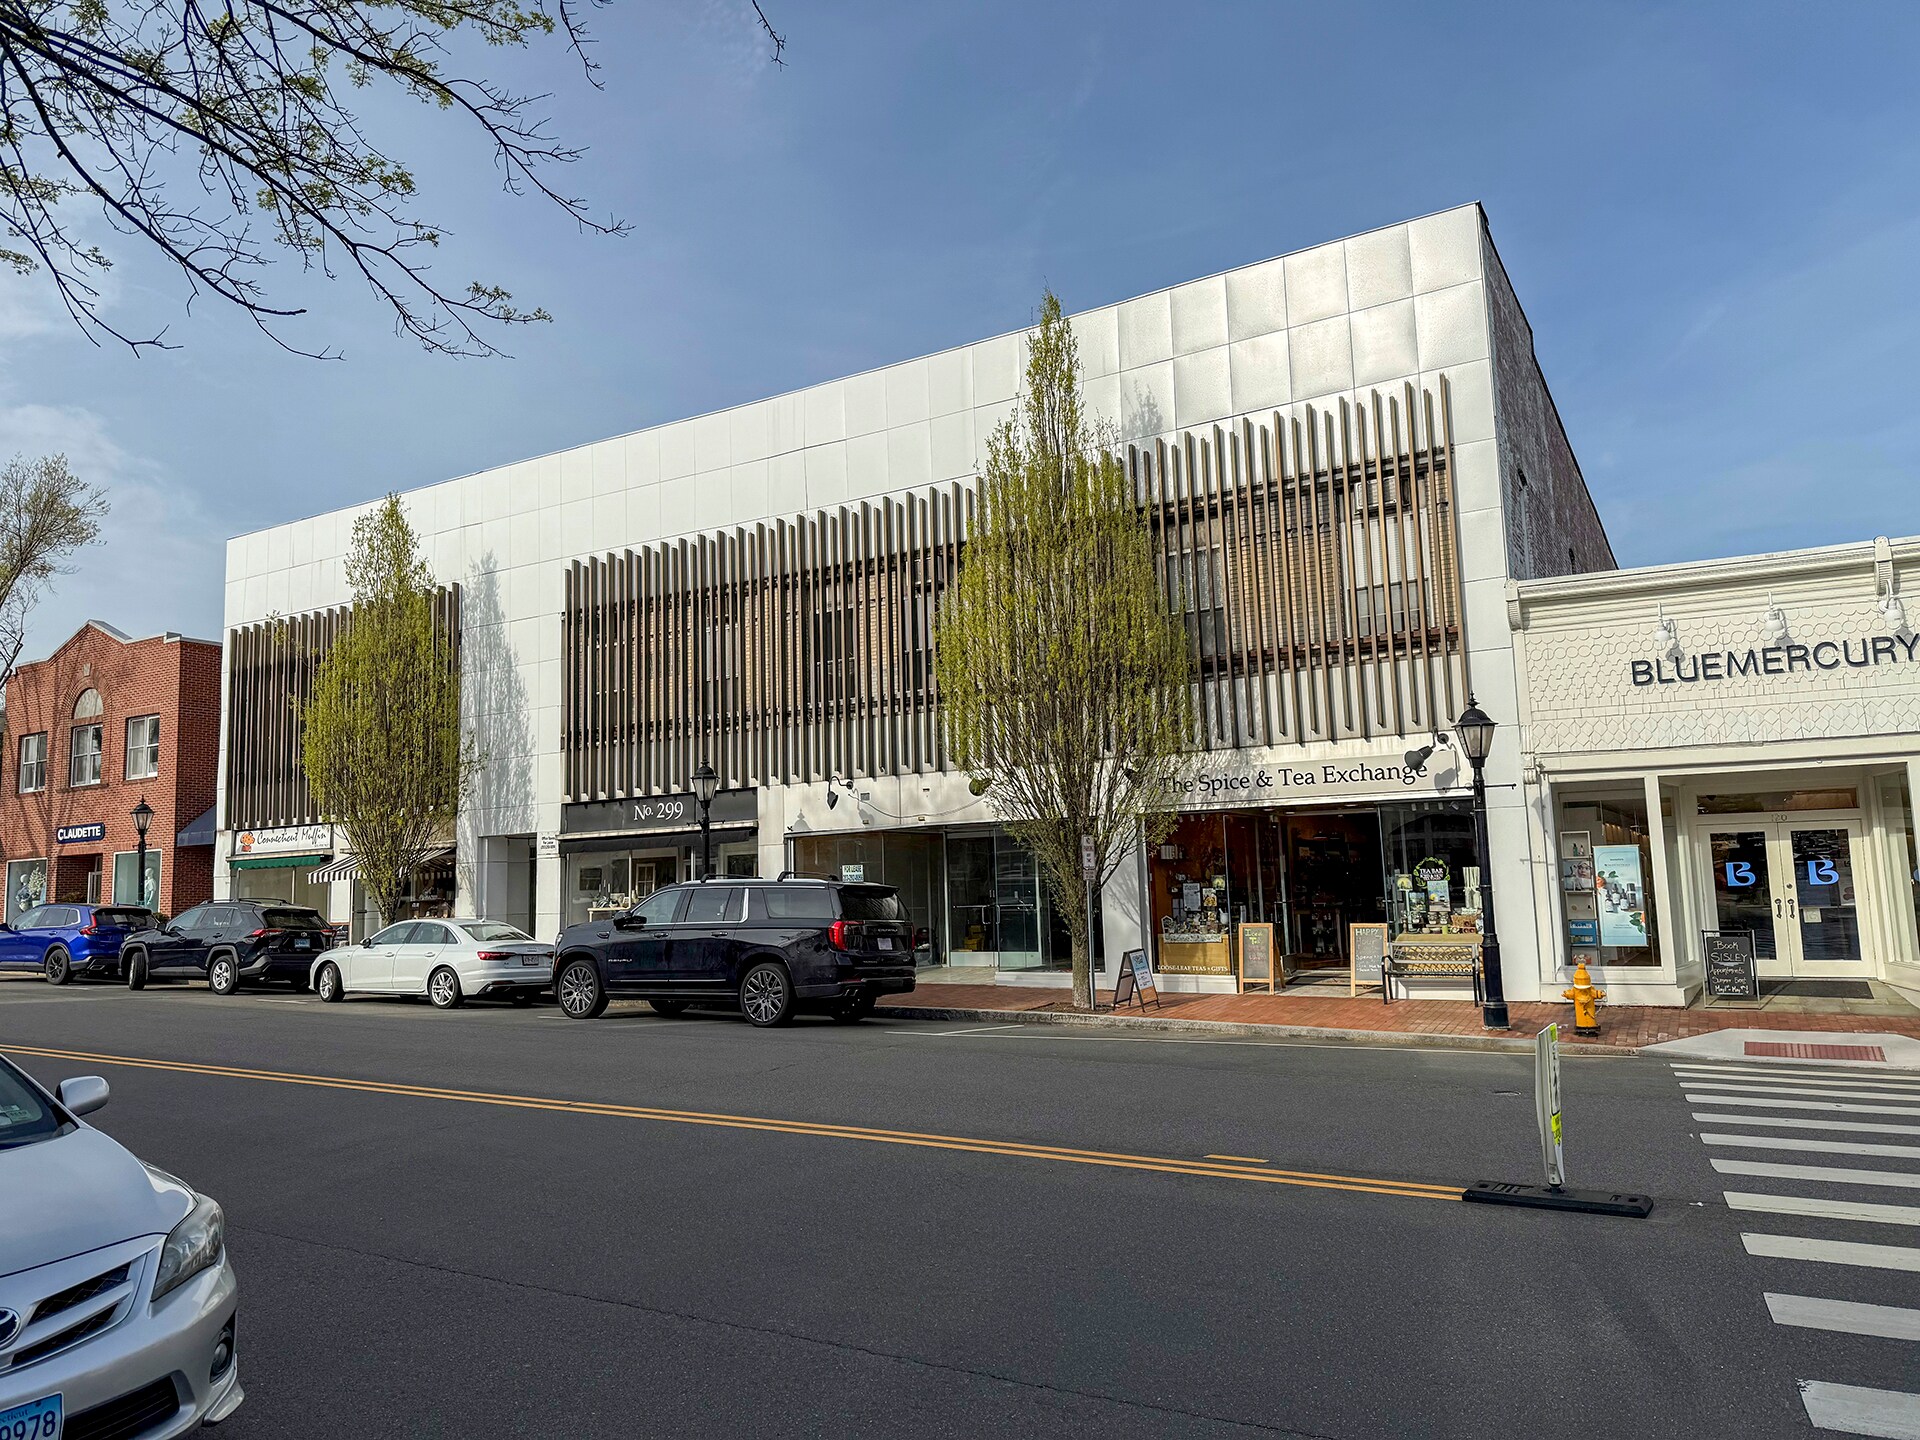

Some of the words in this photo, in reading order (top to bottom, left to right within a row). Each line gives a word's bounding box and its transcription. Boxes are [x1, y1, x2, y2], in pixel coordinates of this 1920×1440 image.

[1631, 633, 1920, 686] BLUEMERCURY
[1159, 776, 1193, 793] The
[1198, 774, 1250, 796] Spice
[1256, 770, 1273, 788] &
[1278, 768, 1316, 786] Tea
[1321, 763, 1428, 785] Exchange
[633, 804, 654, 821] No.
[656, 801, 684, 820] 299
[57, 825, 101, 841] CLAUDETTE
[257, 831, 298, 845] Connecticut
[301, 827, 327, 845] Muffin
[1725, 861, 1756, 887] B
[1807, 860, 1840, 886] B
[1355, 928, 1380, 936] HAPPY
[1710, 952, 1748, 962] SISLEY
